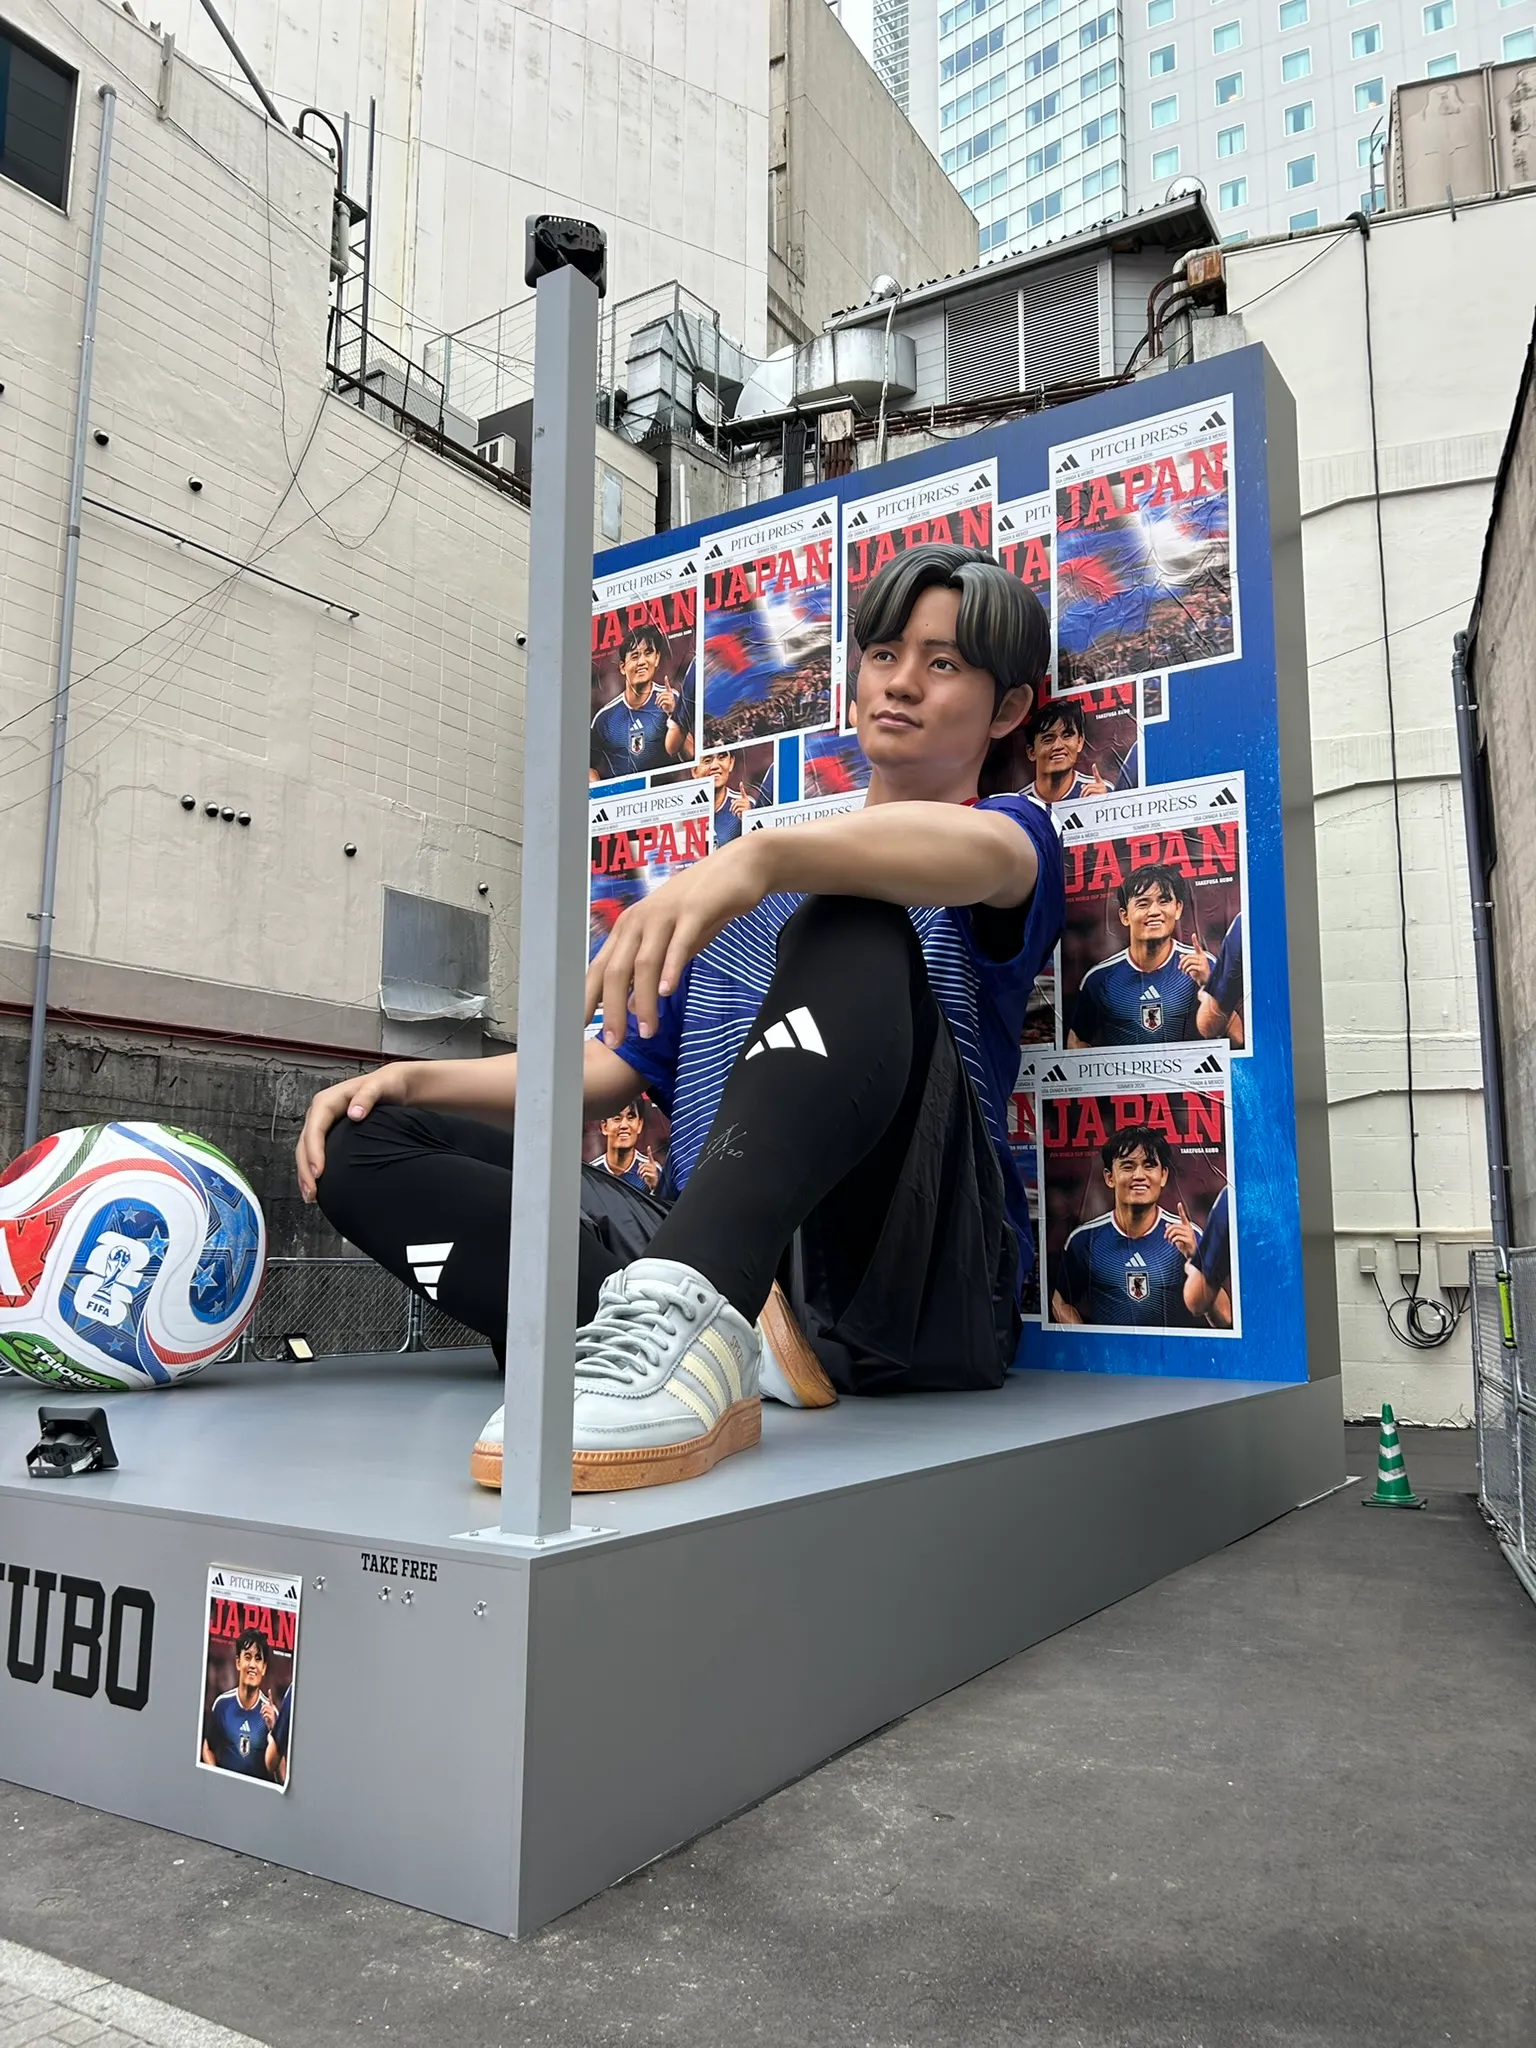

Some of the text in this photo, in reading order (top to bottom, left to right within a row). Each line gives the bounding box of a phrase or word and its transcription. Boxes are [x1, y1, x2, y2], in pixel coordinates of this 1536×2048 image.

[1090, 421, 1188, 461] PITCH PRESS
[877, 496, 916, 518] PITCH
[919, 483, 960, 506] PRESS
[1056, 441, 1228, 532] JAPAN
[1025, 504, 1051, 523] PIT
[731, 531, 765, 552] PITCH
[768, 519, 804, 541] PRESS
[606, 578, 637, 598] PITCH
[640, 568, 672, 588] PRESS
[704, 537, 832, 612] JAPAN
[616, 802, 648, 818] PITCH
[650, 795, 684, 812] PRESS
[775, 812, 811, 828] PITCH
[1095, 794, 1198, 824] PITCH PRESS
[591, 816, 710, 875] JAPAN
[1064, 821, 1239, 894] JAPAN
[1079, 1058, 1182, 1078] PITCH PRESS
[1043, 1090, 1224, 1147] JAPAN
[86, 1301, 110, 1317] FIFA
[361, 1552, 438, 1582] TAKE FREE
[230, 1576, 280, 1594] PITCH PRESS
[0, 1562, 155, 1712] UBO
[210, 1597, 297, 1650] JAPAN
